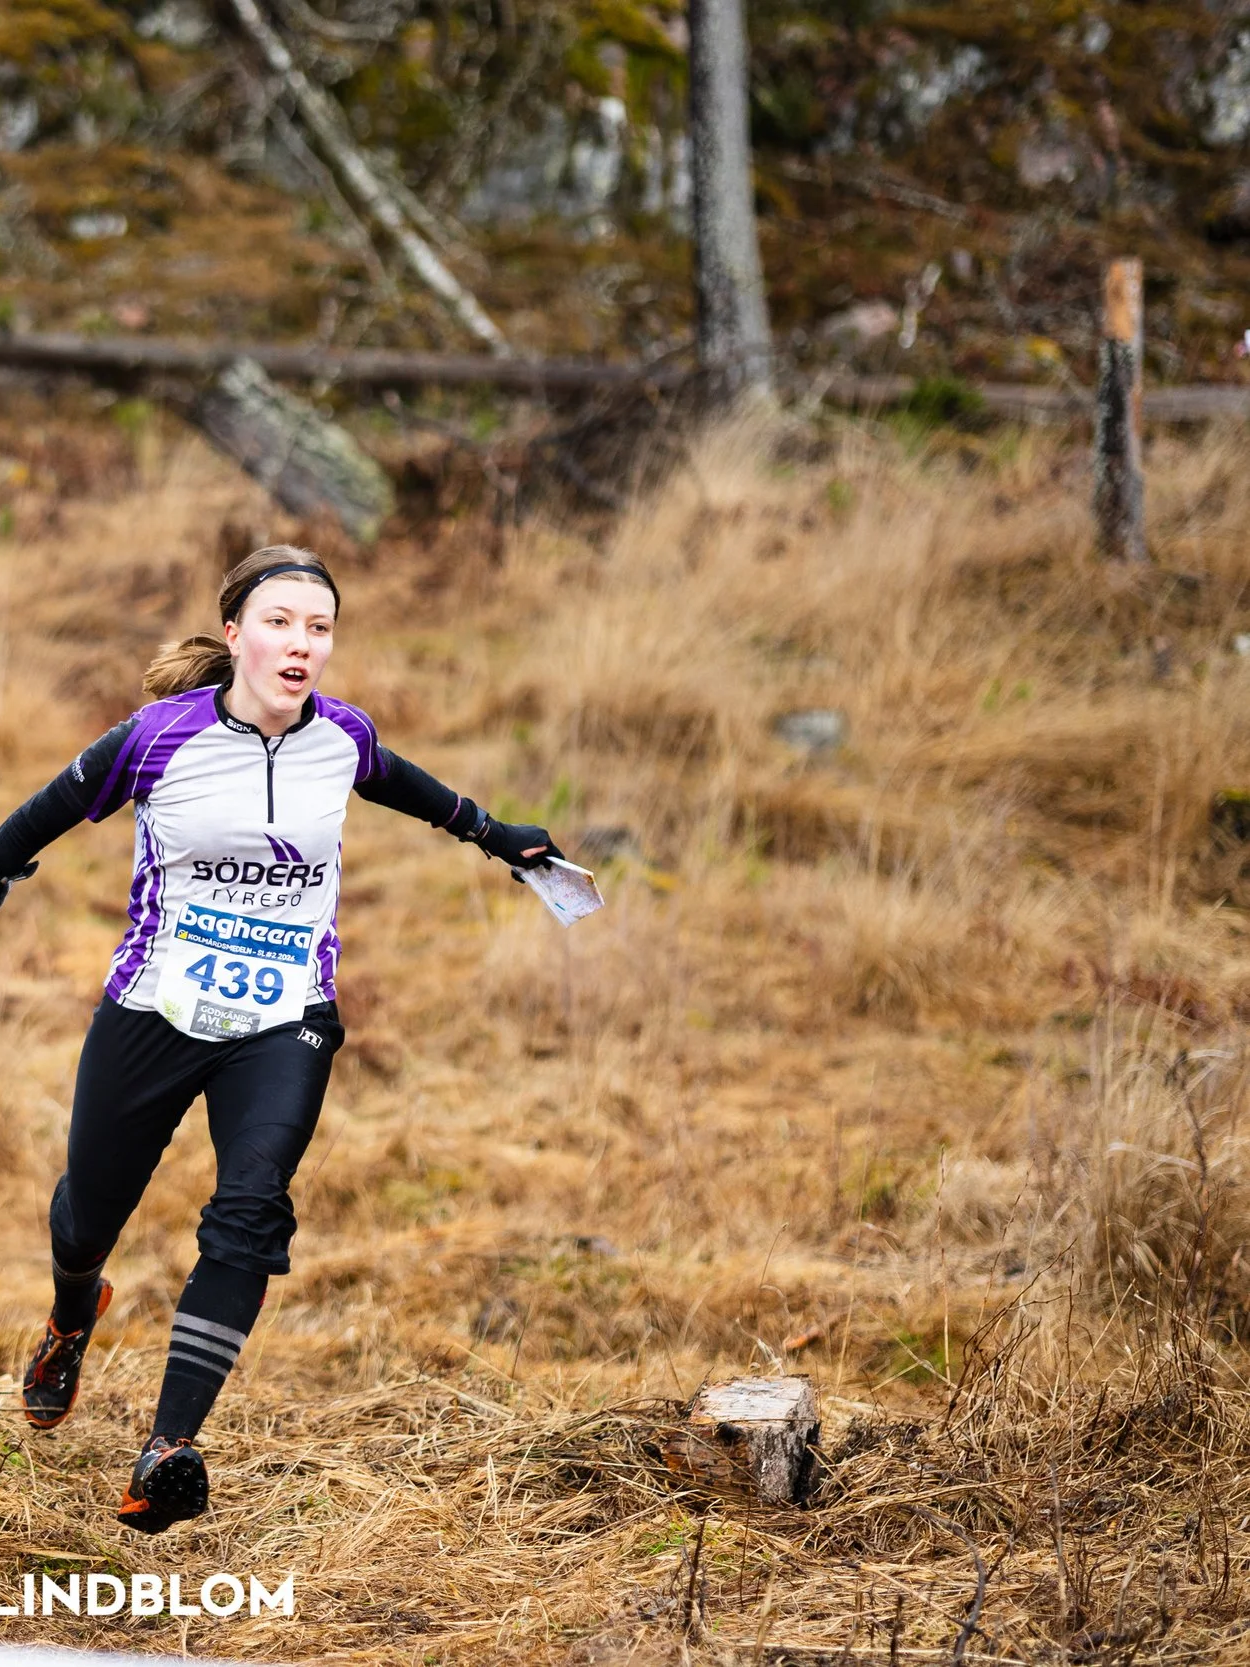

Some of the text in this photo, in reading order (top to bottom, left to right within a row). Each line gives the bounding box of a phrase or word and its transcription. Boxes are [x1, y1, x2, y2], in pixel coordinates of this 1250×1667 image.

[191, 857, 328, 888] SÖDERS
[178, 904, 313, 949] bagheera
[184, 953, 284, 1005] 439
[200, 1005, 254, 1024] GODKÄNDA
